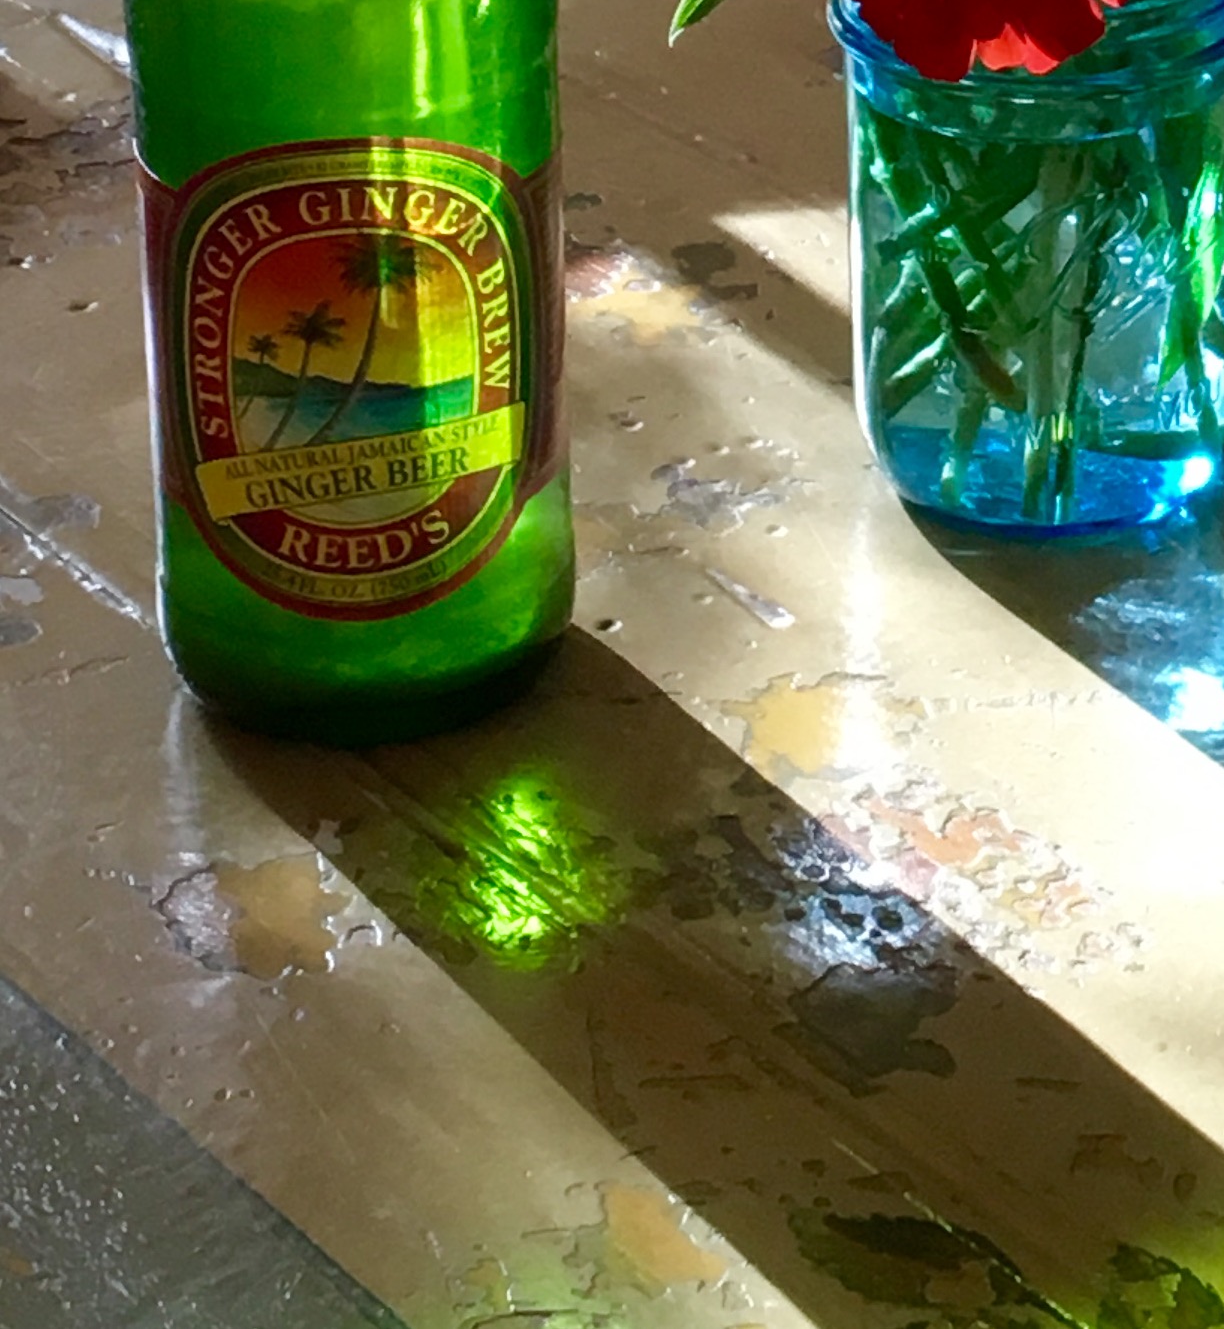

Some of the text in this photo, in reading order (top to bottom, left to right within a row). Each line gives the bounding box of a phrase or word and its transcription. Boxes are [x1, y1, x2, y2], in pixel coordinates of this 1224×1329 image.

[193, 185, 511, 439] STRONGER GINGER BREW
[254, 447, 340, 474] NATURAL
[348, 430, 446, 465] JAMAICAN
[452, 413, 498, 441] STYLE
[245, 446, 469, 509] GINGER BEER
[277, 509, 450, 569] REED'S
